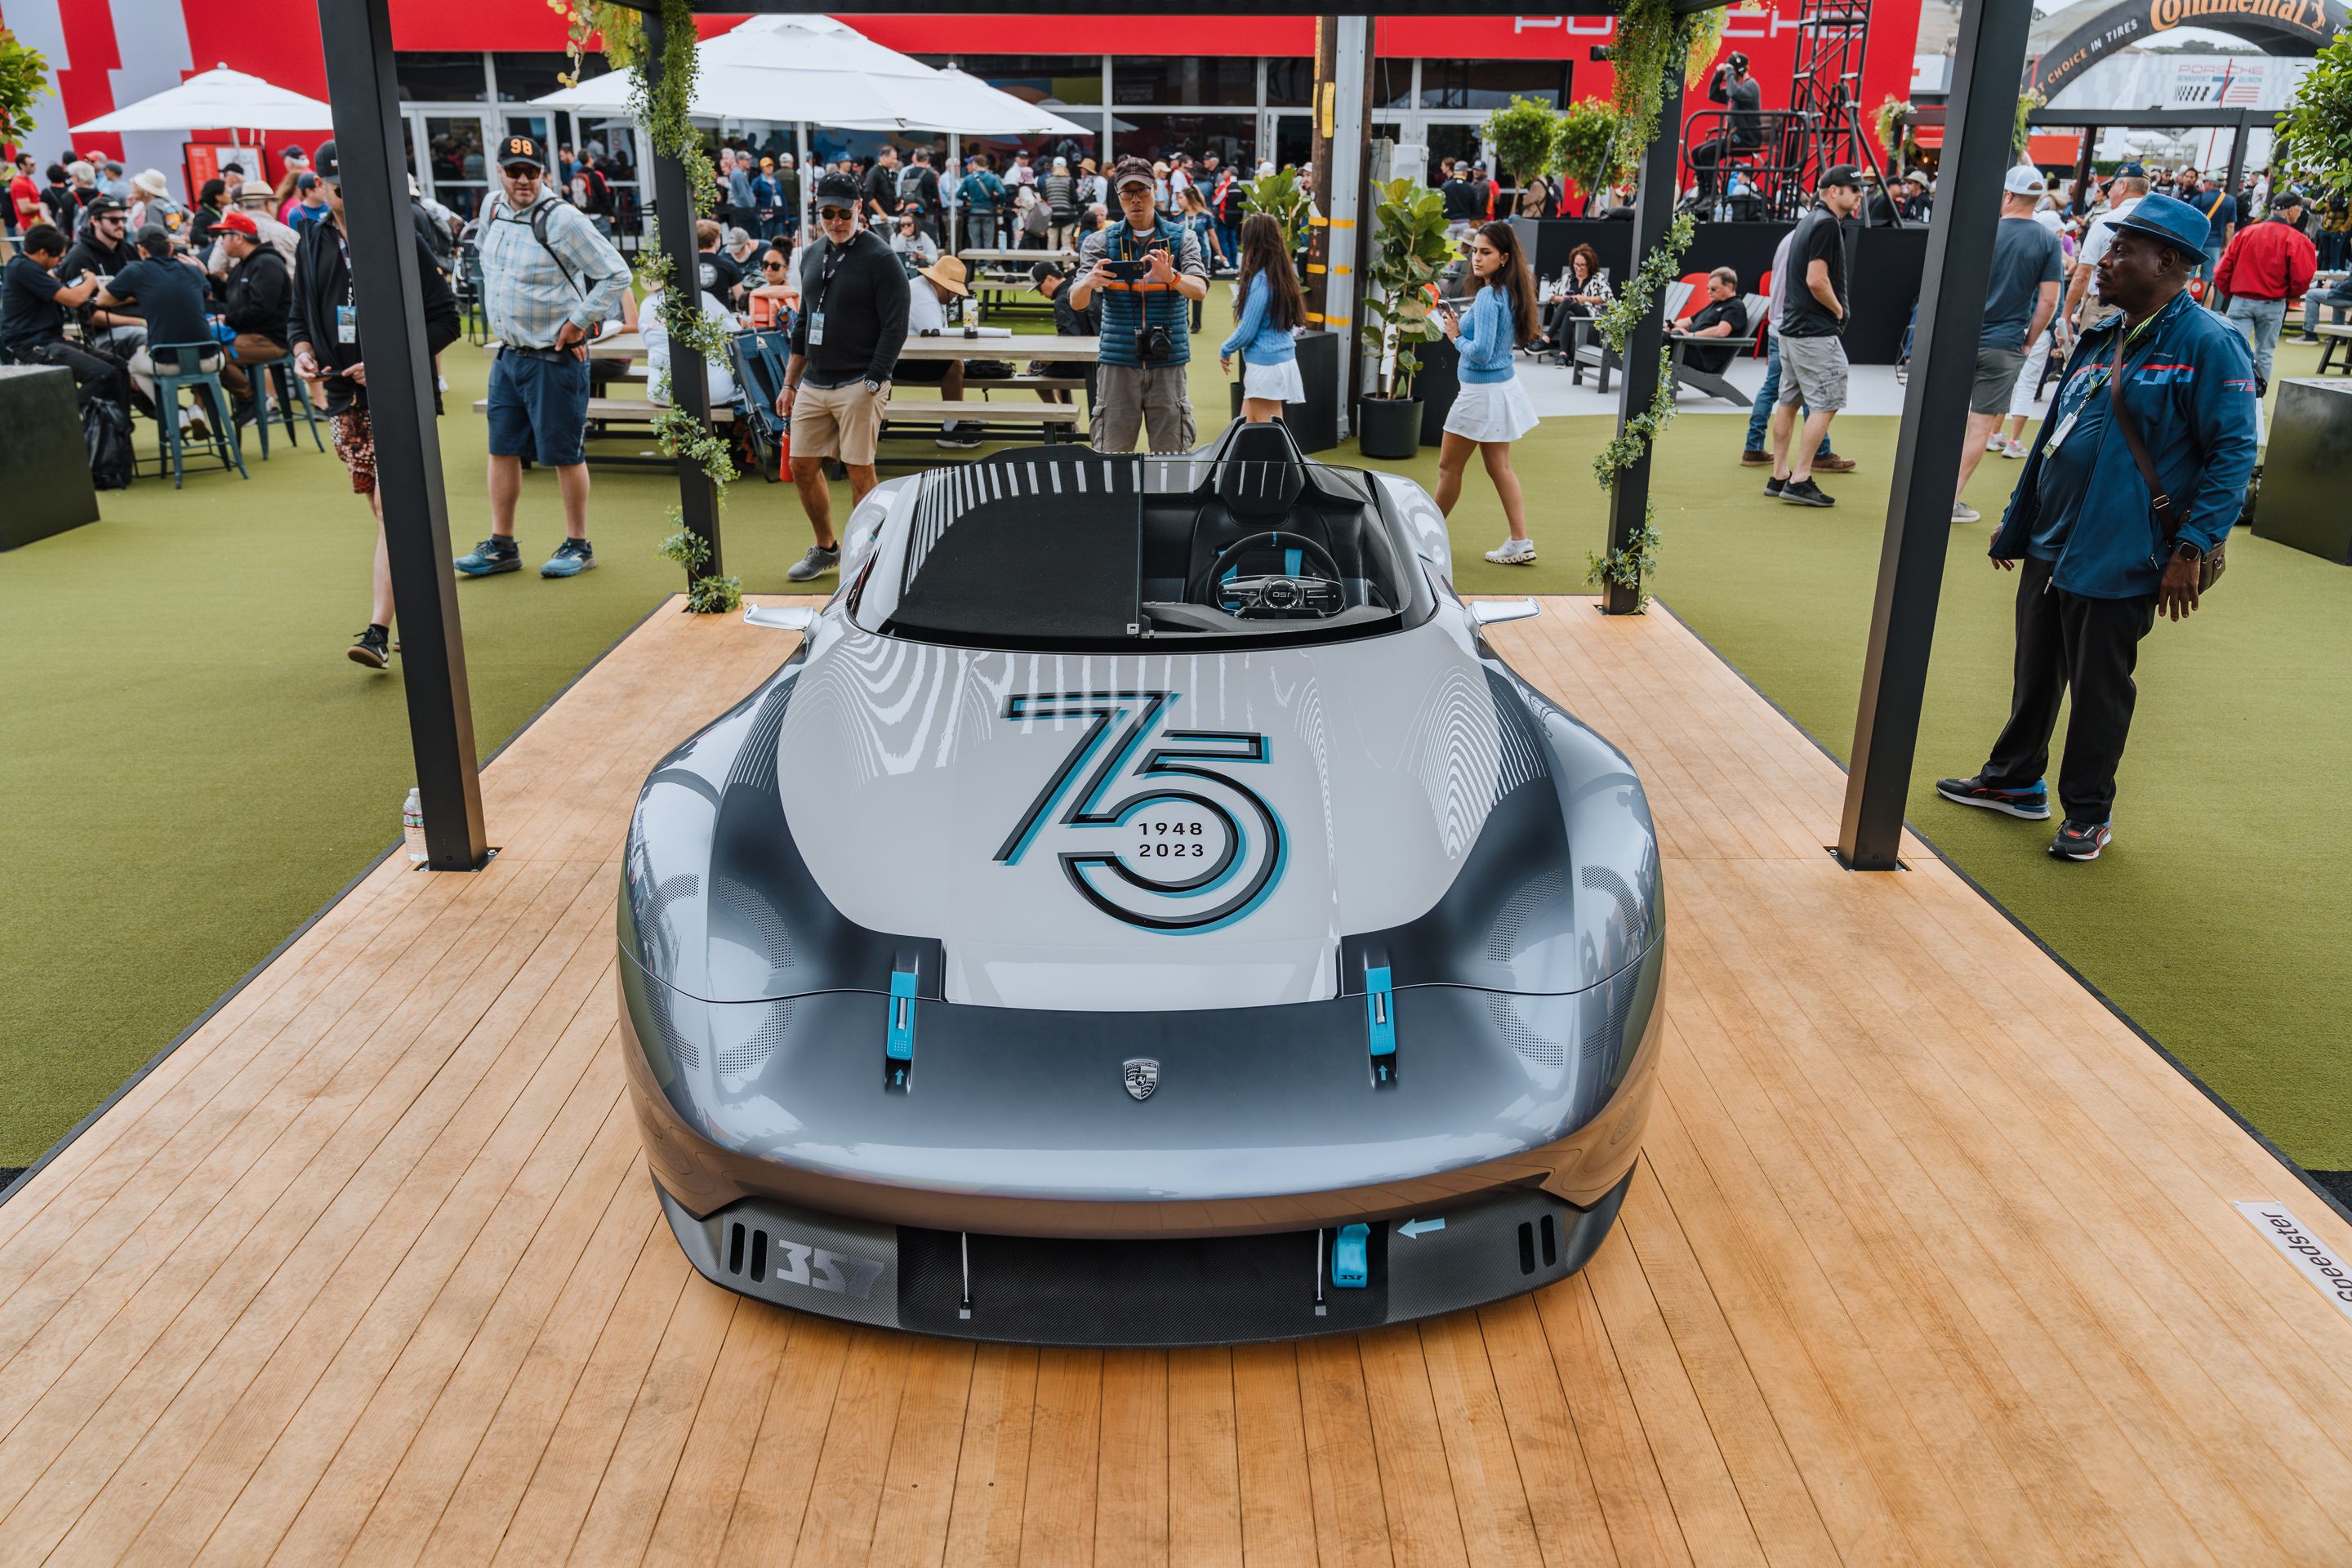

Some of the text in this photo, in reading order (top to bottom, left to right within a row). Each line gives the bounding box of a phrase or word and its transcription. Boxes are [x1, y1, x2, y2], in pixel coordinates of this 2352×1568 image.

[1514, 10, 1865, 38] POCHE
[2047, 18, 2138, 84] CHOICE IN TIRES
[2178, 65, 2264, 74] PORSCHE
[992, 690, 1291, 936] 75
[1138, 822, 1202, 835] 1948
[1139, 844, 1204, 858] 2023
[777, 1240, 884, 1300] 357
